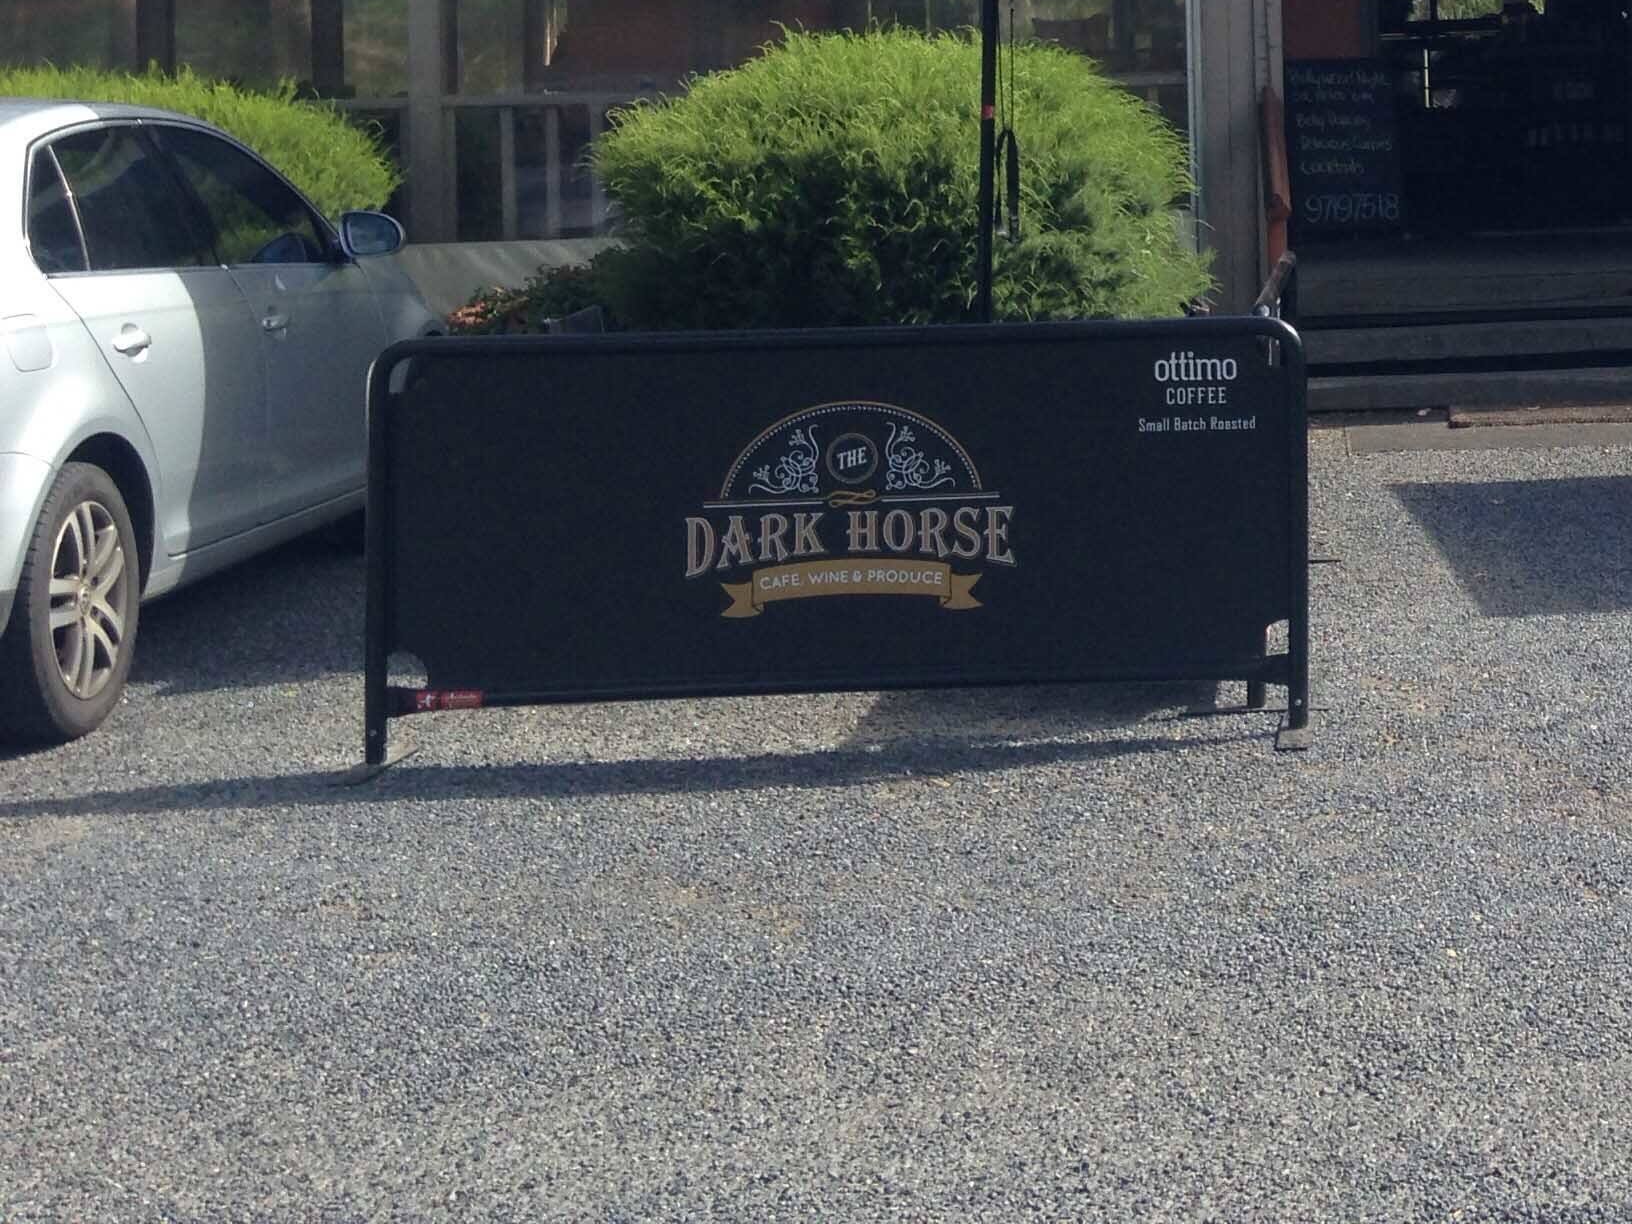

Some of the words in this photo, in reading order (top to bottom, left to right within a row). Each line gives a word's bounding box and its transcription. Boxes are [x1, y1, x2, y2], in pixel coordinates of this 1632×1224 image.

[1154, 351, 1238, 381] ottimo
[1166, 387, 1227, 405] COFFEE
[1138, 418, 1170, 432] Small
[1174, 417, 1206, 431] Batch
[1210, 416, 1256, 430] Roasted
[836, 447, 867, 470] THE
[685, 511, 827, 577] DARK
[845, 505, 1017, 567] HORSE
[808, 571, 850, 585] WINE
[852, 571, 863, 583] &
[867, 569, 944, 585] PRODUCE
